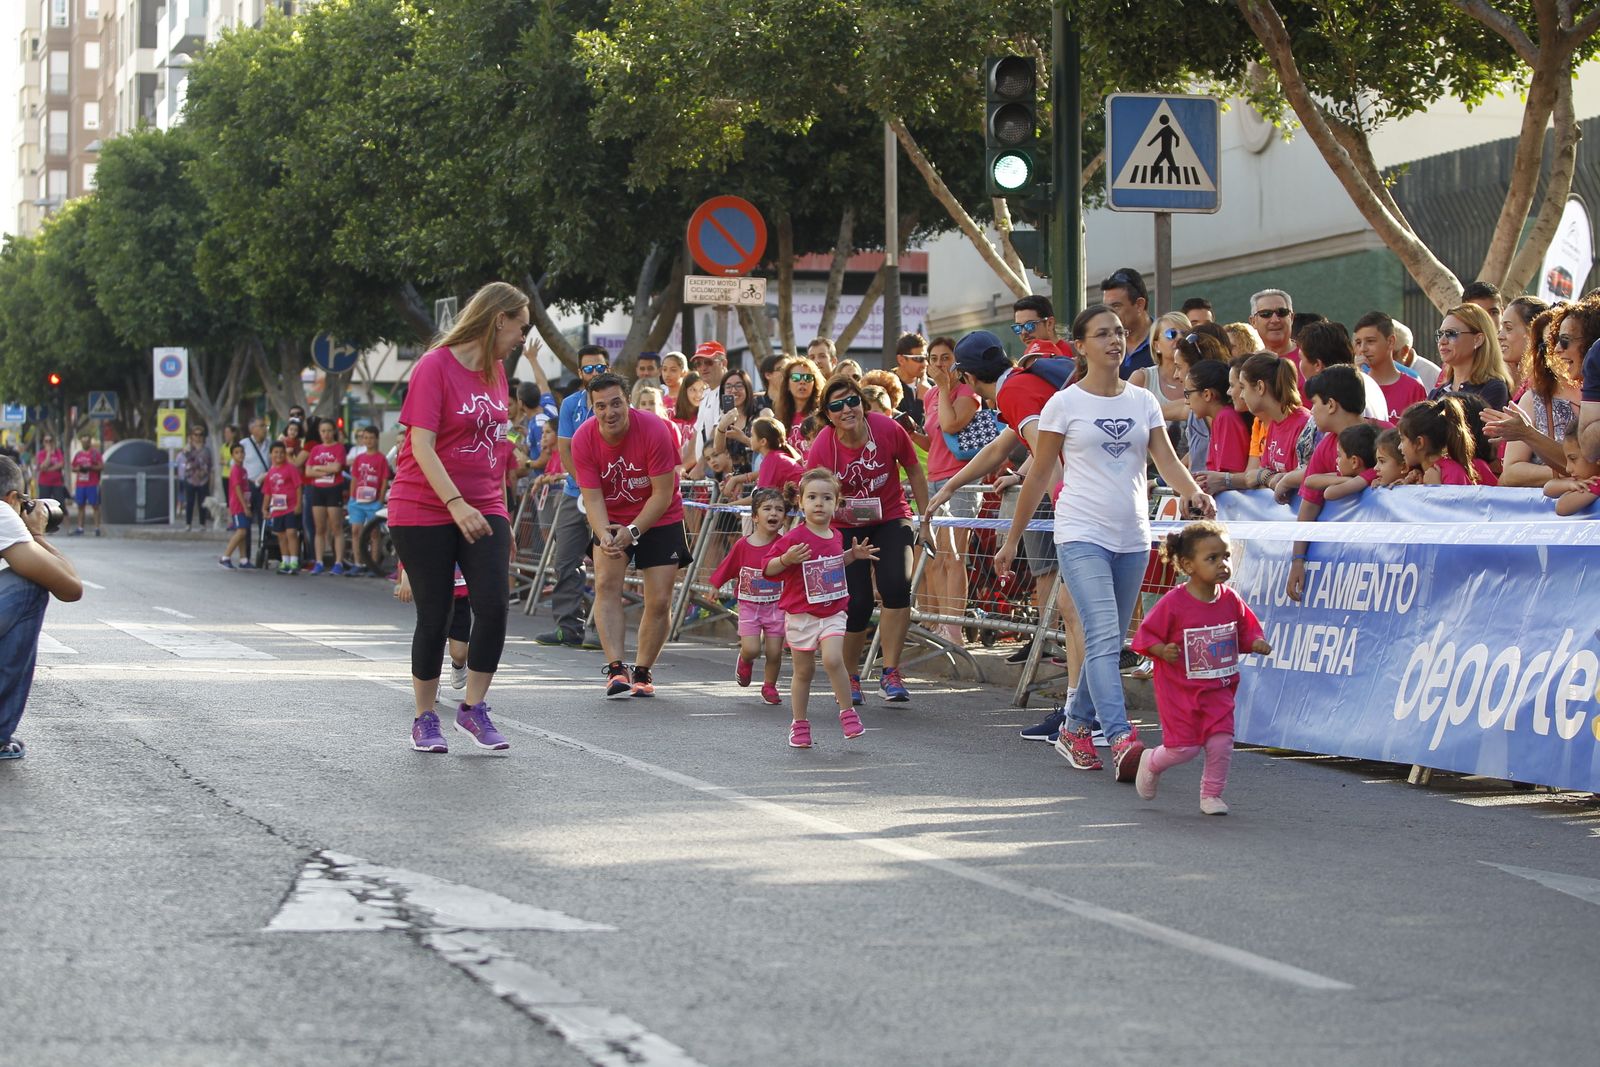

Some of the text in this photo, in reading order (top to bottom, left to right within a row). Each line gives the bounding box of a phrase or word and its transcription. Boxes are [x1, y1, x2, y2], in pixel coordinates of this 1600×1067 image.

[792, 303, 859, 315] CIGARLO
[1248, 560, 1418, 614] AYUTAMIENTO
[1262, 615, 1358, 676] ALMERÍA
[1393, 621, 1600, 751] deporte
